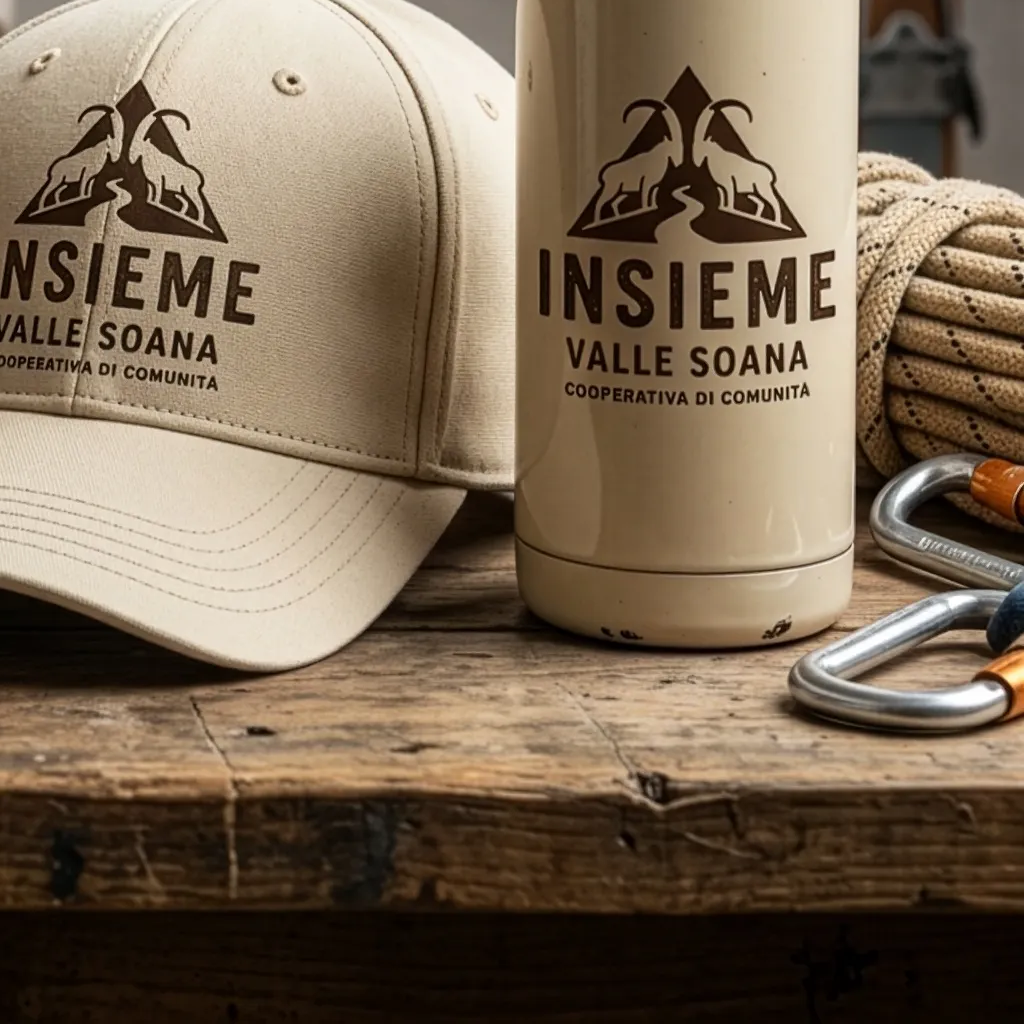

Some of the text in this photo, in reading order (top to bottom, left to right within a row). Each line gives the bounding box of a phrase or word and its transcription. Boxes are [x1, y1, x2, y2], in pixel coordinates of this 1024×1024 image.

[539, 248, 836, 330] INSIEME
[98, 321, 218, 364] SOANA
[566, 336, 809, 378] VALLE SOANA
[98, 362, 117, 377] DI
[123, 365, 218, 391] COMUNITA
[564, 381, 810, 406] COOPERATIVA DI COMUNITA
